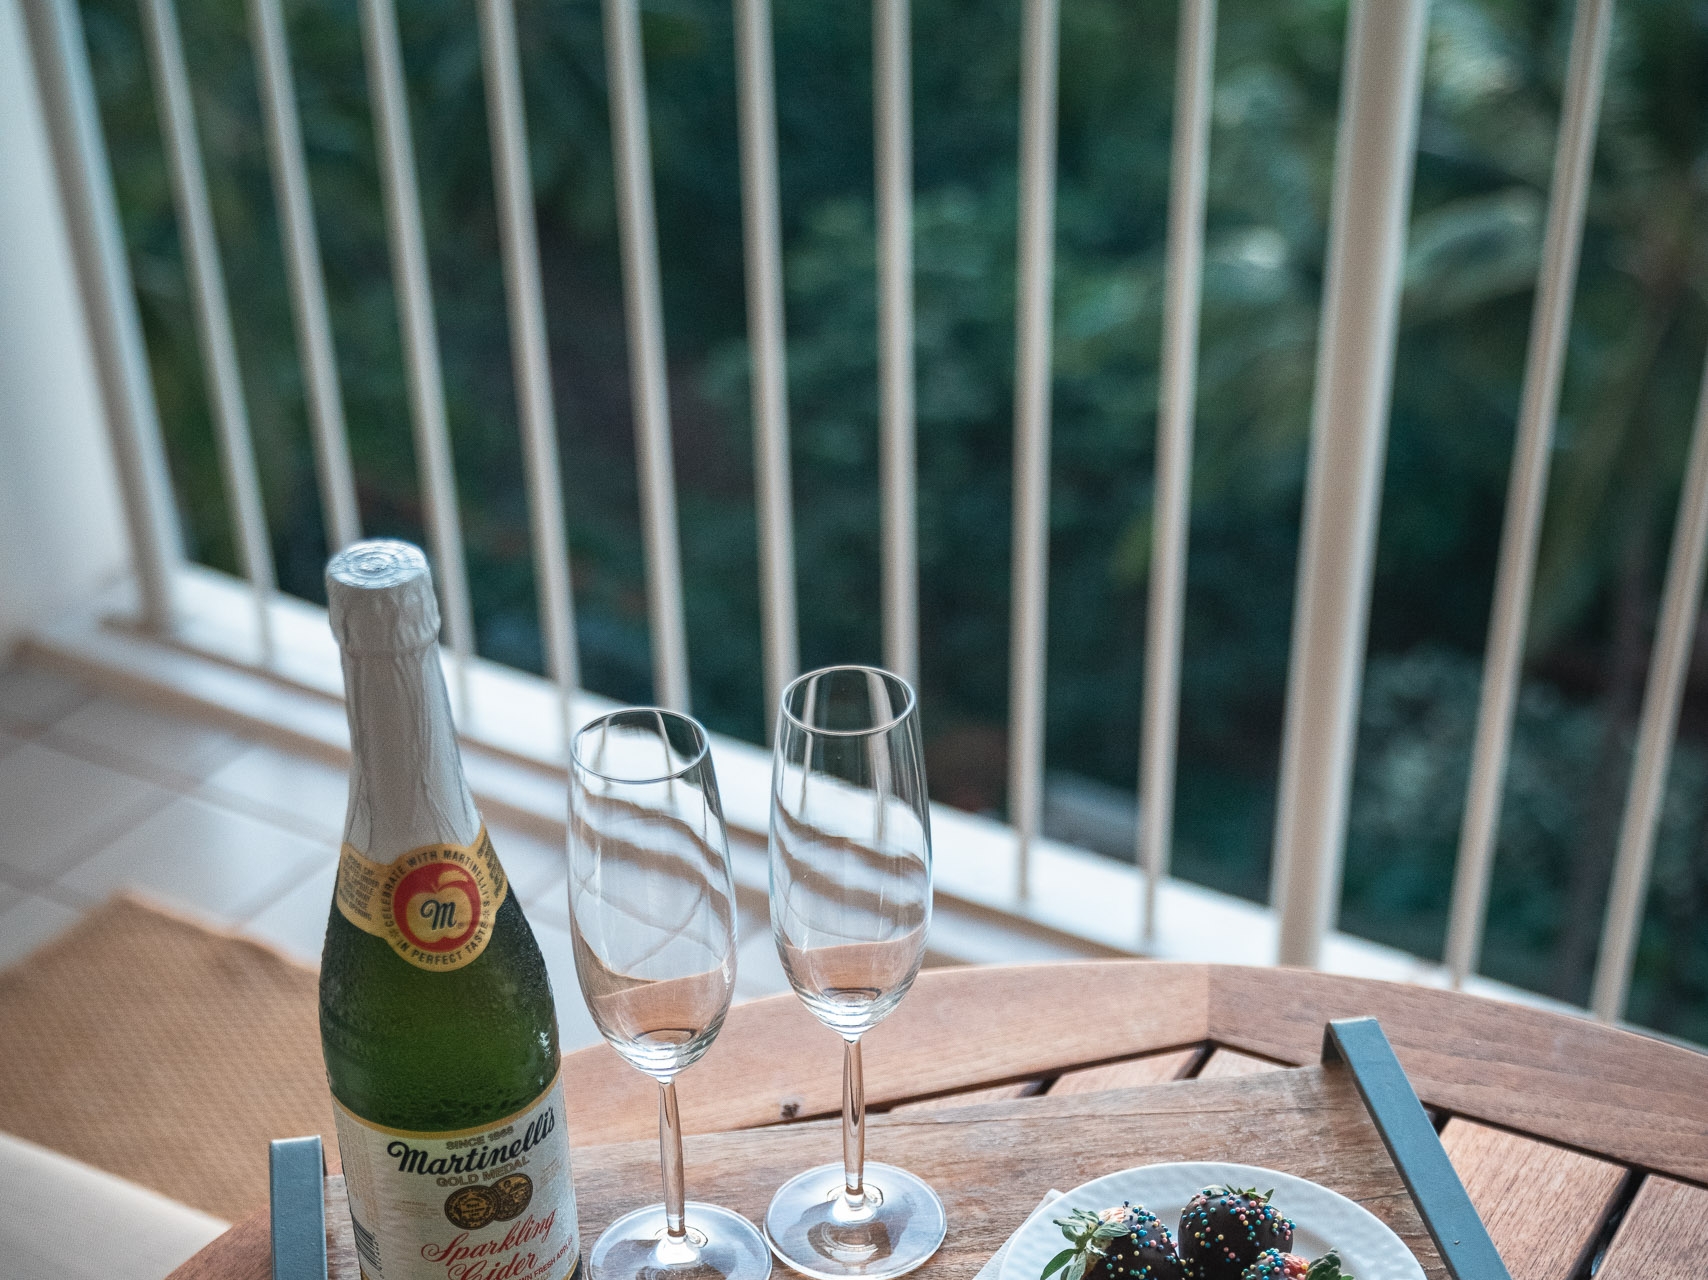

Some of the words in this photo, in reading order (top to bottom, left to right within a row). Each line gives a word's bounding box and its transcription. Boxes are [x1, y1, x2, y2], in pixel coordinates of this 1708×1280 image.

[381, 865, 406, 927] CELEBRATE
[407, 851, 438, 867] WITH
[443, 850, 491, 908] MARTINELLI'S
[396, 939, 410, 952] IN
[411, 949, 463, 965] PERFECT
[465, 921, 489, 953] TASTE
[387, 1106, 555, 1175] Martinelli's
[446, 1135, 486, 1150] SINCE
[436, 1173, 479, 1187] GOLD
[483, 1156, 530, 1181] MEDAL
[421, 1208, 557, 1266] Sparkling
[533, 1257, 555, 1277] FRESH
